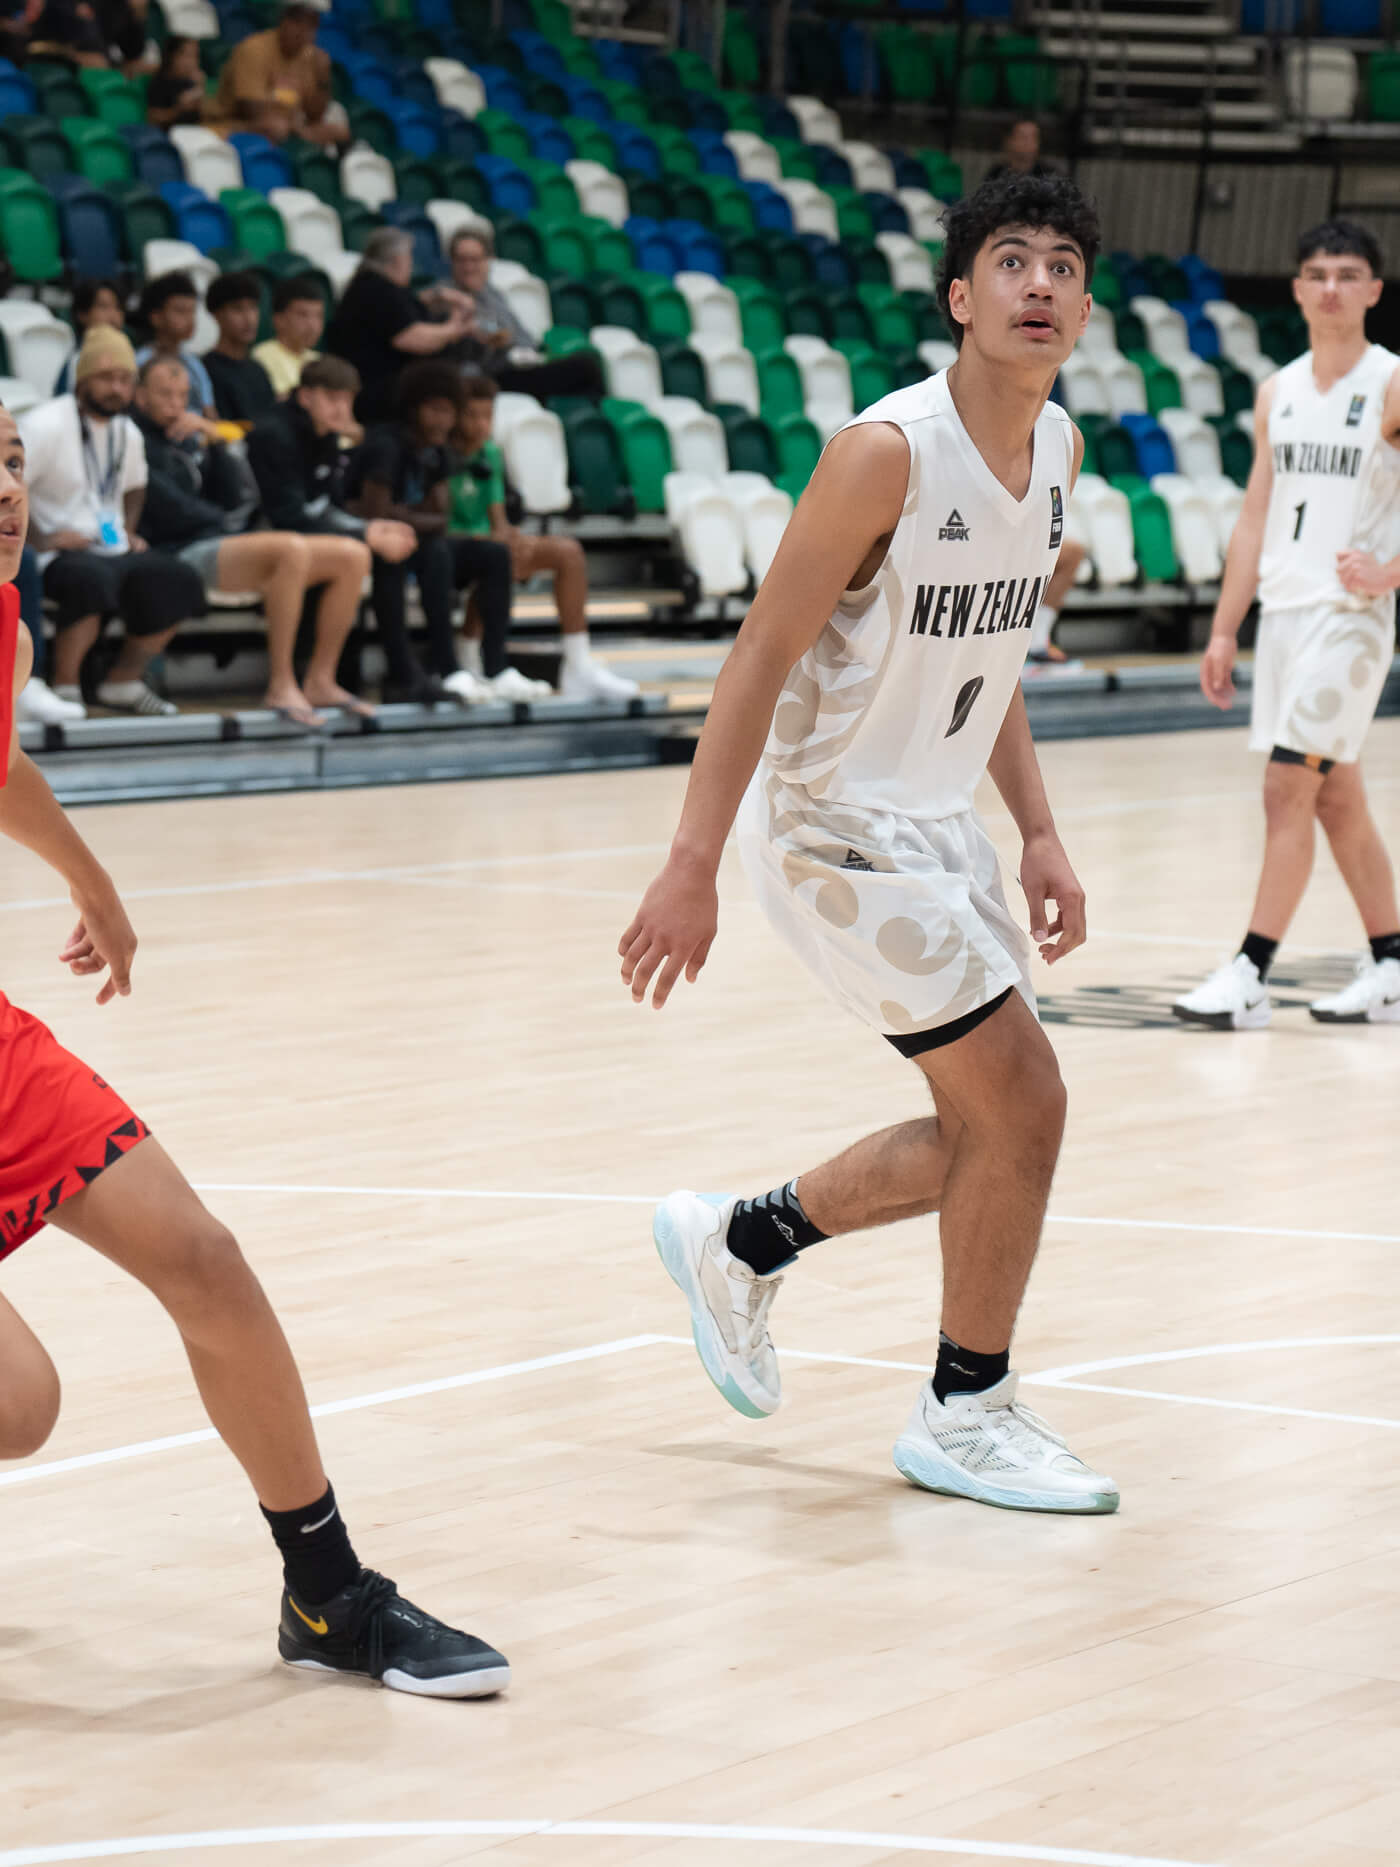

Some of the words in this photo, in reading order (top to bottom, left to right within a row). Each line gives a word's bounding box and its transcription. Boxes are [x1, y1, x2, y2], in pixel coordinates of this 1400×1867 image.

[1298, 442, 1362, 478] ZEALAND
[938, 528, 971, 541] PEAK
[1294, 500, 1307, 541] 1
[909, 584, 977, 638] NEW
